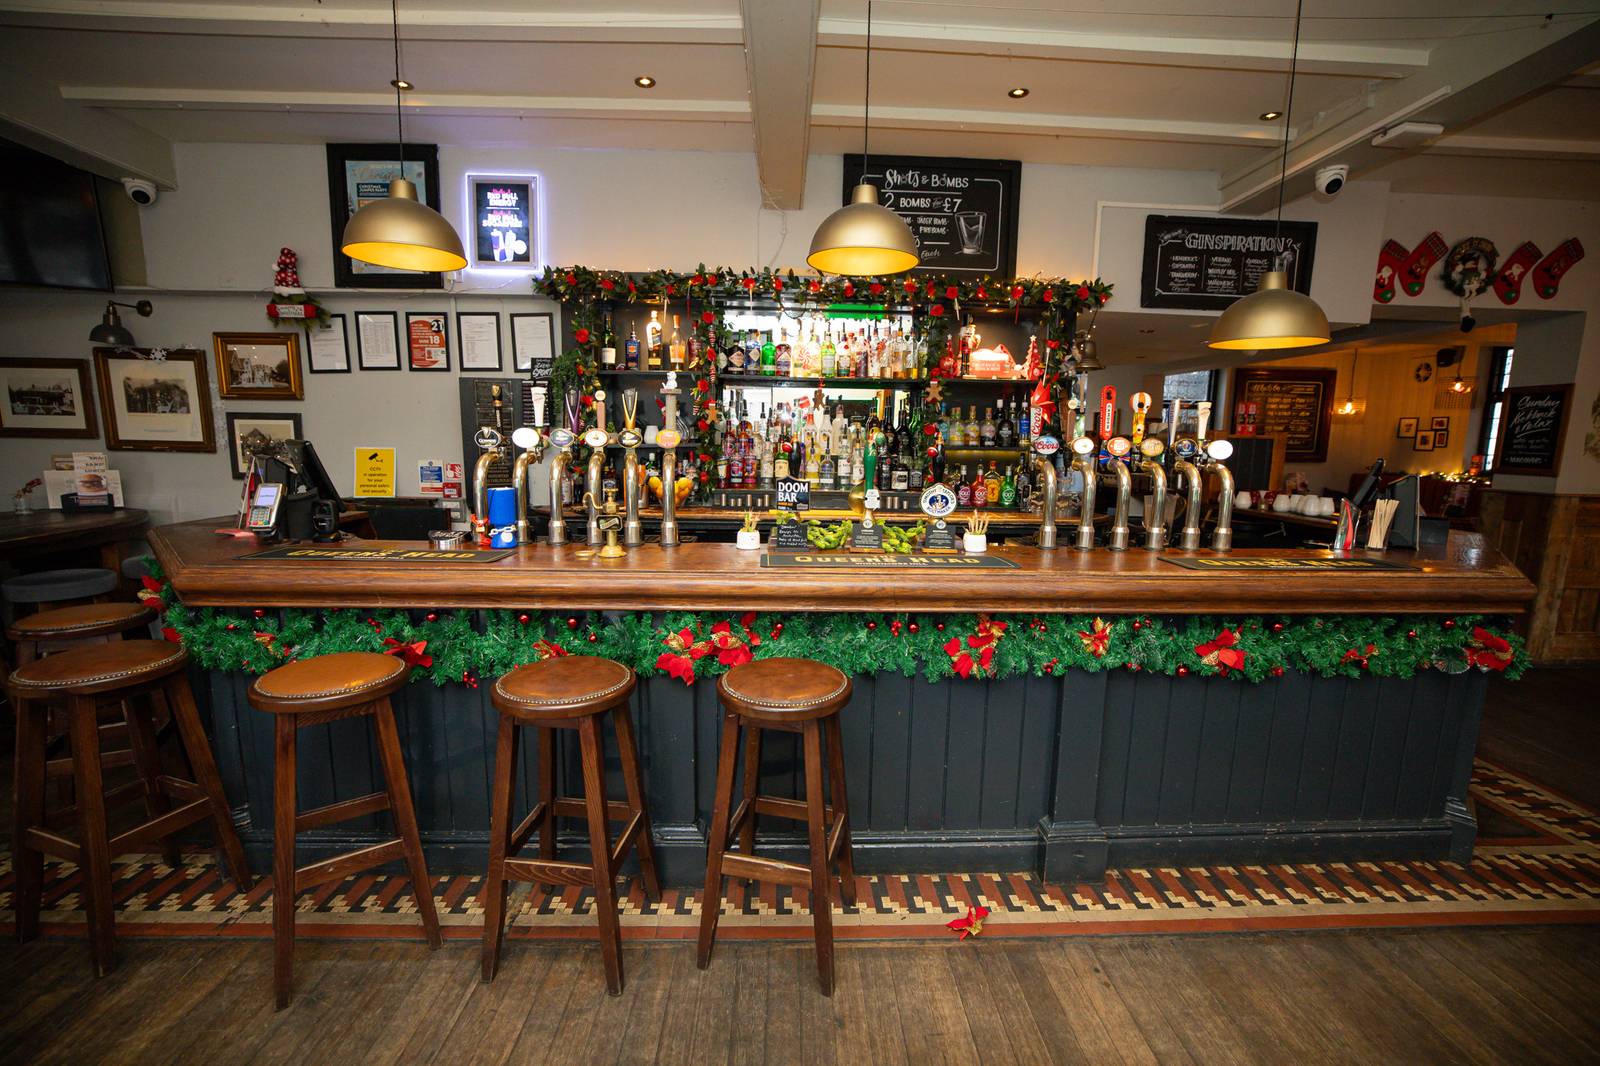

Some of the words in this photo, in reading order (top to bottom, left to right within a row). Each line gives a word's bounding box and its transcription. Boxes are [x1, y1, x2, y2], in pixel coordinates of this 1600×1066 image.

[885, 169, 920, 190] Shots
[921, 175, 929, 184] &
[931, 173, 969, 188] BOMBS
[900, 197, 931, 208] BOMBS
[943, 197, 963, 212] £7
[432, 321, 443, 331] 21
[430, 335, 440, 344] 18
[1031, 407, 1042, 435] Coors
[1035, 440, 1059, 450] Coors
[777, 481, 809, 493] DOOM
[777, 491, 798, 502] BAR
